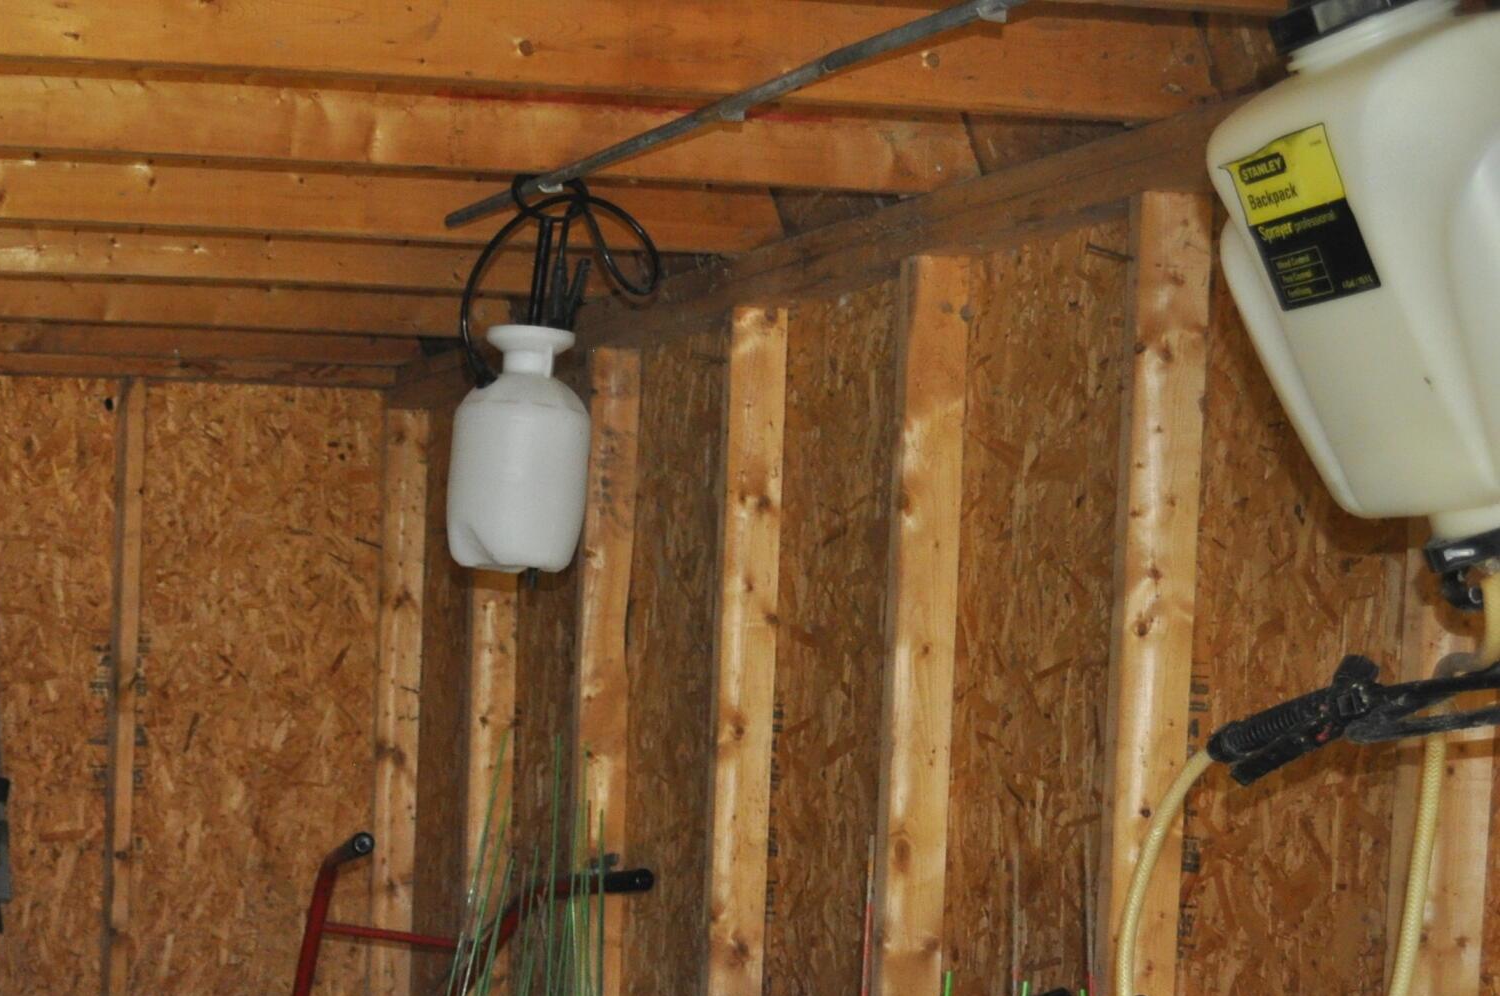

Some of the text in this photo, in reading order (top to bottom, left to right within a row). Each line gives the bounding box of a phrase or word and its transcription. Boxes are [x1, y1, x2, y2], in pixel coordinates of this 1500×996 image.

[1241, 158, 1283, 181] STANLEY
[1247, 182, 1298, 211] Backpack
[1258, 222, 1293, 244] Sprayer
